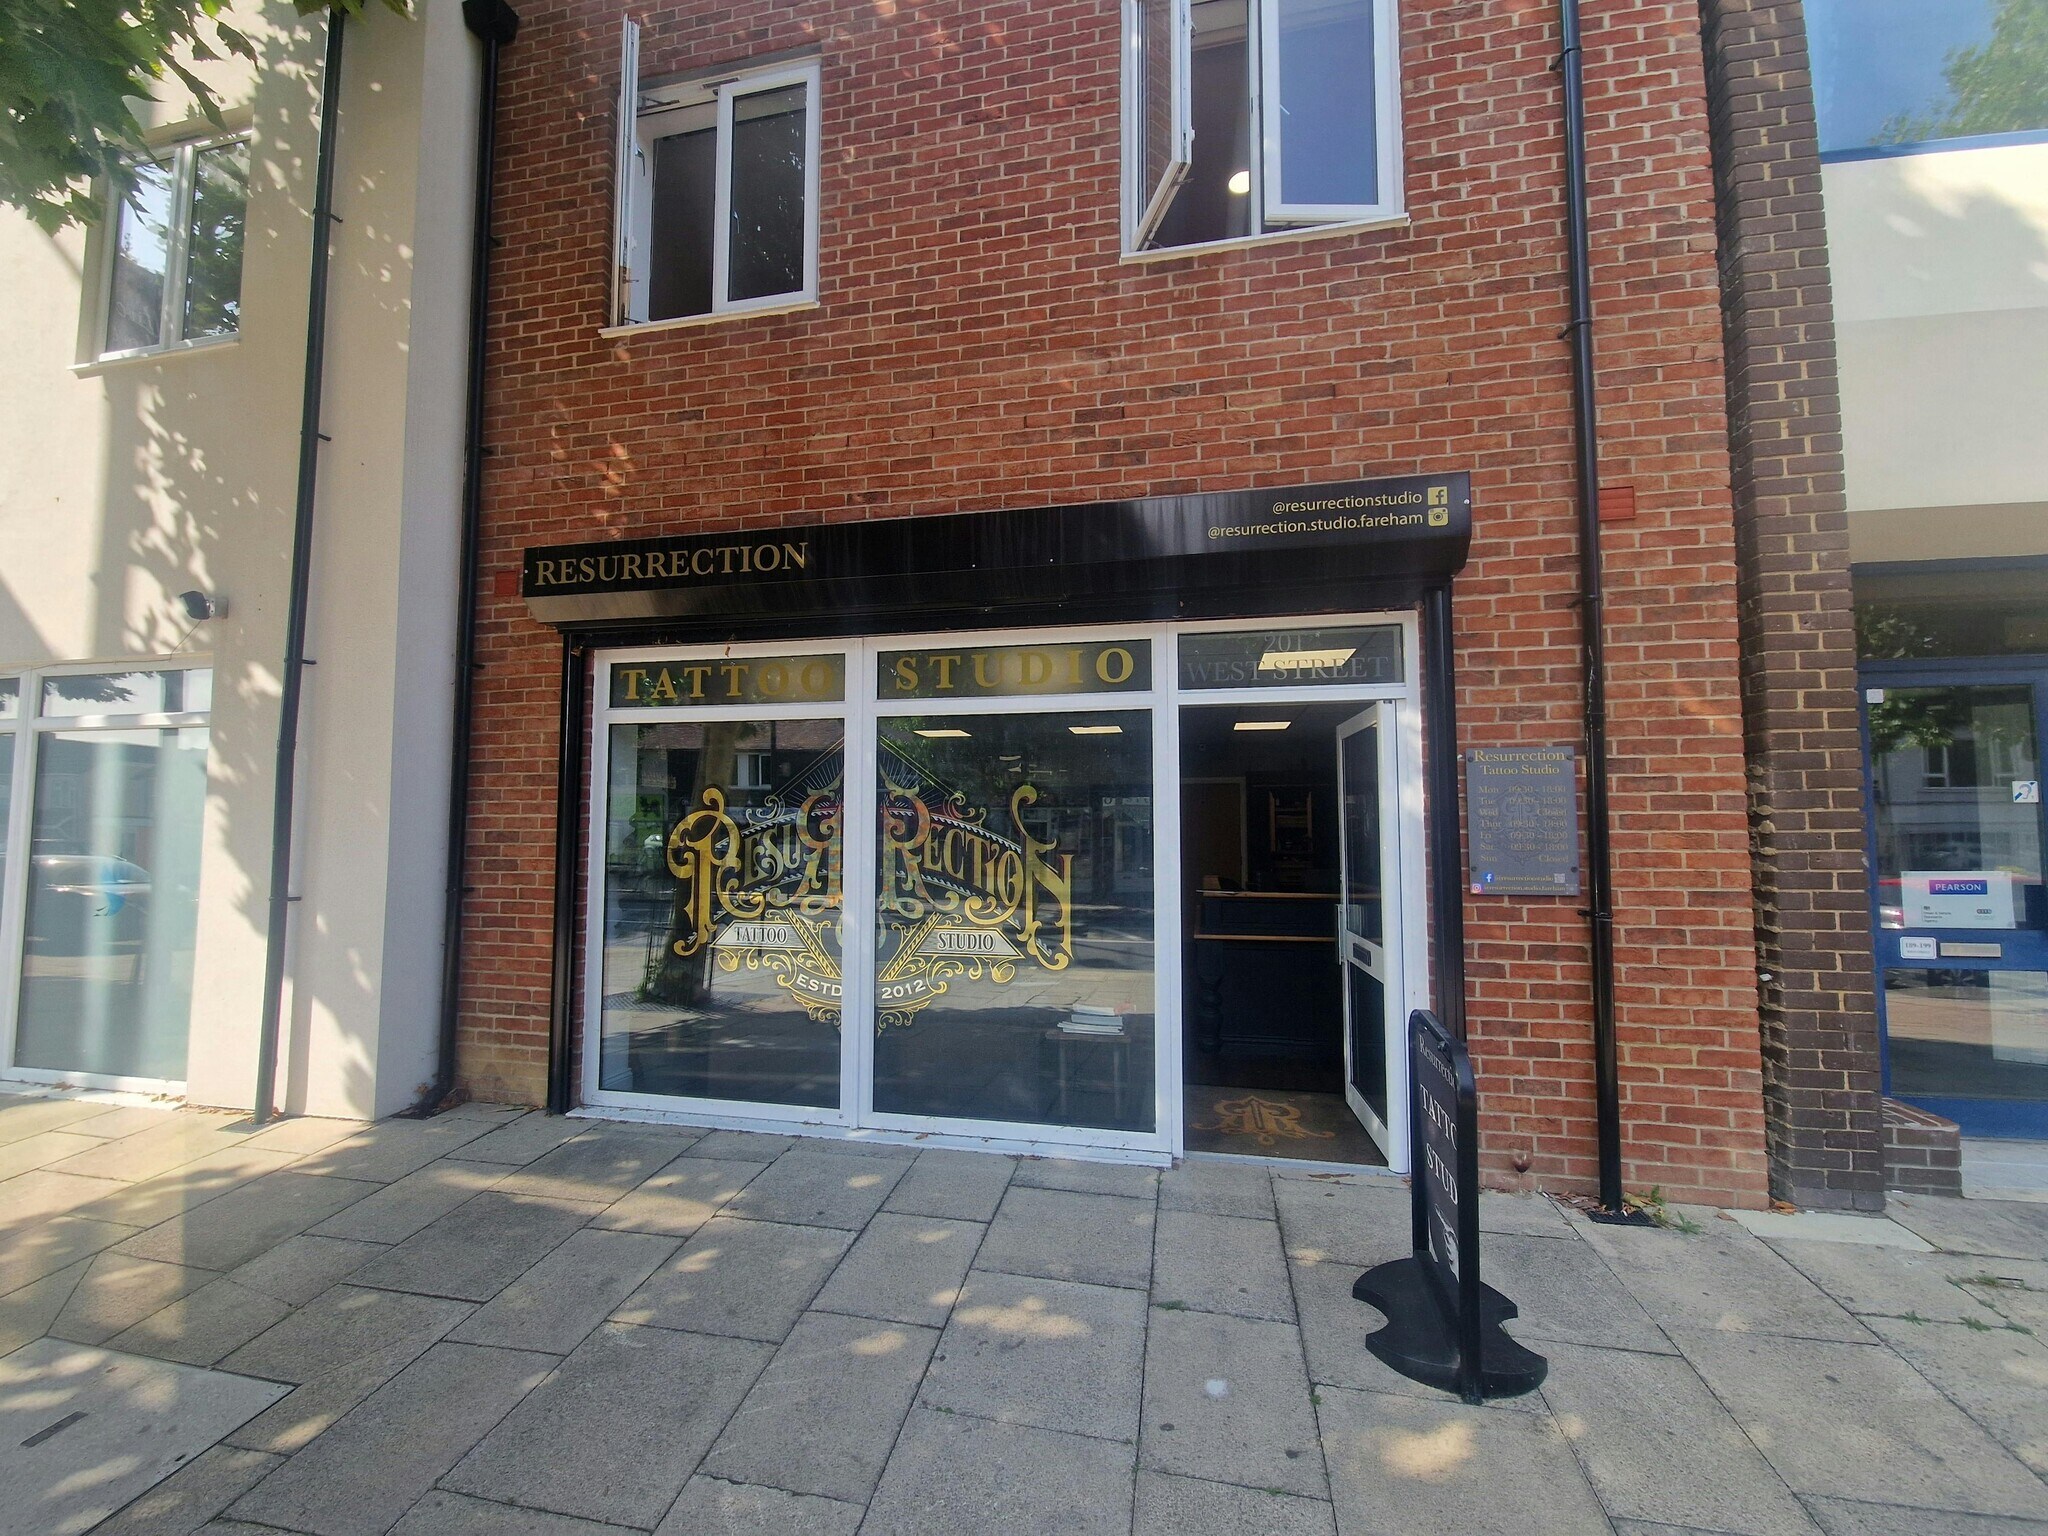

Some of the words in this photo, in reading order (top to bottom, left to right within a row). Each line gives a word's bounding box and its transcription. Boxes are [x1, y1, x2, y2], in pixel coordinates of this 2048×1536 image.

[1272, 491, 1423, 515] @resurrectionstudio
[1207, 511, 1424, 540] @resurrection.studio.fareham
[534, 541, 809, 586] RESURRECTION
[619, 661, 835, 700] TATTOO
[895, 647, 1135, 691] STUDIO
[1186, 659, 1266, 683] WEST
[1272, 655, 1390, 680] STREET
[1474, 749, 1566, 763] Resurrection
[1480, 764, 1519, 775] Tattoo
[1521, 764, 1560, 775] Studio
[1935, 883, 1982, 892] PEARSON
[733, 926, 788, 944] TATTOO
[937, 932, 996, 951] STUDIO
[796, 973, 842, 997] ESTD
[881, 979, 926, 999] 2012
